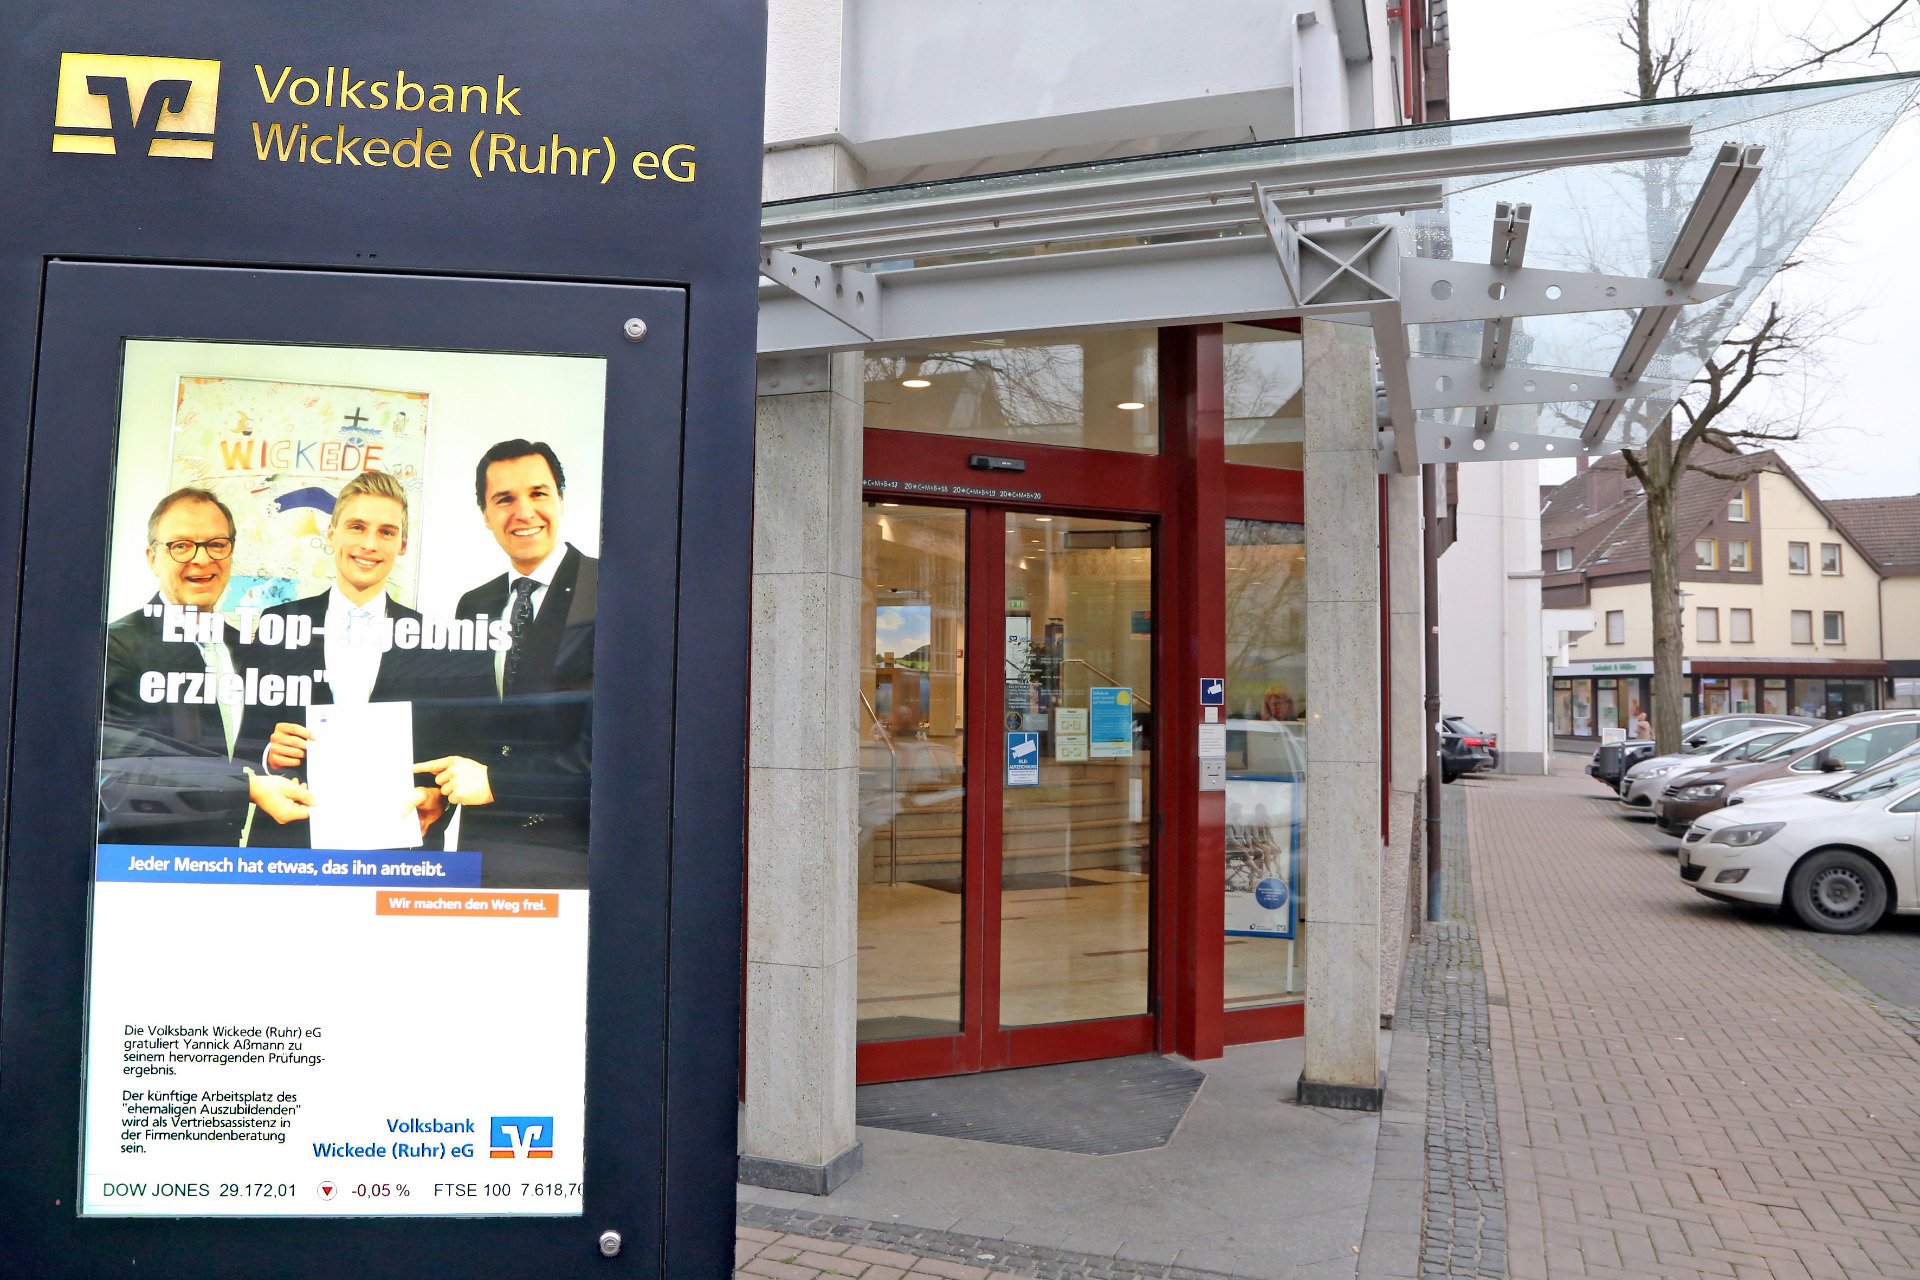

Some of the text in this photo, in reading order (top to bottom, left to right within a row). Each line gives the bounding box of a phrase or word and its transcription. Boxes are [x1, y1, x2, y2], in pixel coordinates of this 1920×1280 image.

[253, 64, 522, 116] Volksbank
[251, 121, 697, 184] Wickede (Ruhr) eG
[219, 438, 384, 473] WICKEDE
[142, 603, 514, 653] "Ein Top-Egebnis
[139, 666, 329, 707] erzielen"
[127, 856, 446, 877] Jeder Mensch hat etwas, das ihn antreibt.
[388, 897, 547, 913] Wir machen den Weg frei.
[124, 1025, 322, 1039] Die Volksbank Wickede (Ruhr) eG
[124, 1038, 302, 1051] gratuliert Yannick Aßmann zu
[123, 1051, 326, 1067] seinem hervorragenden Prüfungs-
[123, 1064, 177, 1078] ergebnis.
[122, 1090, 297, 1106] Der künftige Arbeitsplatz des
[122, 1103, 301, 1116] "ehemaligen Auszubildenden"
[121, 1116, 291, 1128] wird als Vertriebsassistenz in
[386, 1118, 475, 1134] Volksbank
[121, 1129, 286, 1144] der Firmenkundenberatung
[120, 1142, 147, 1153] sein.
[312, 1142, 474, 1160] Wickede (Ruhr) eG
[103, 1183, 147, 1197] DOW
[151, 1183, 210, 1197] JONES
[219, 1183, 296, 1199] 29.172,01
[351, 1183, 391, 1200] -0,05
[395, 1183, 411, 1197] %
[434, 1183, 478, 1197] FTSE
[483, 1183, 511, 1197] 100
